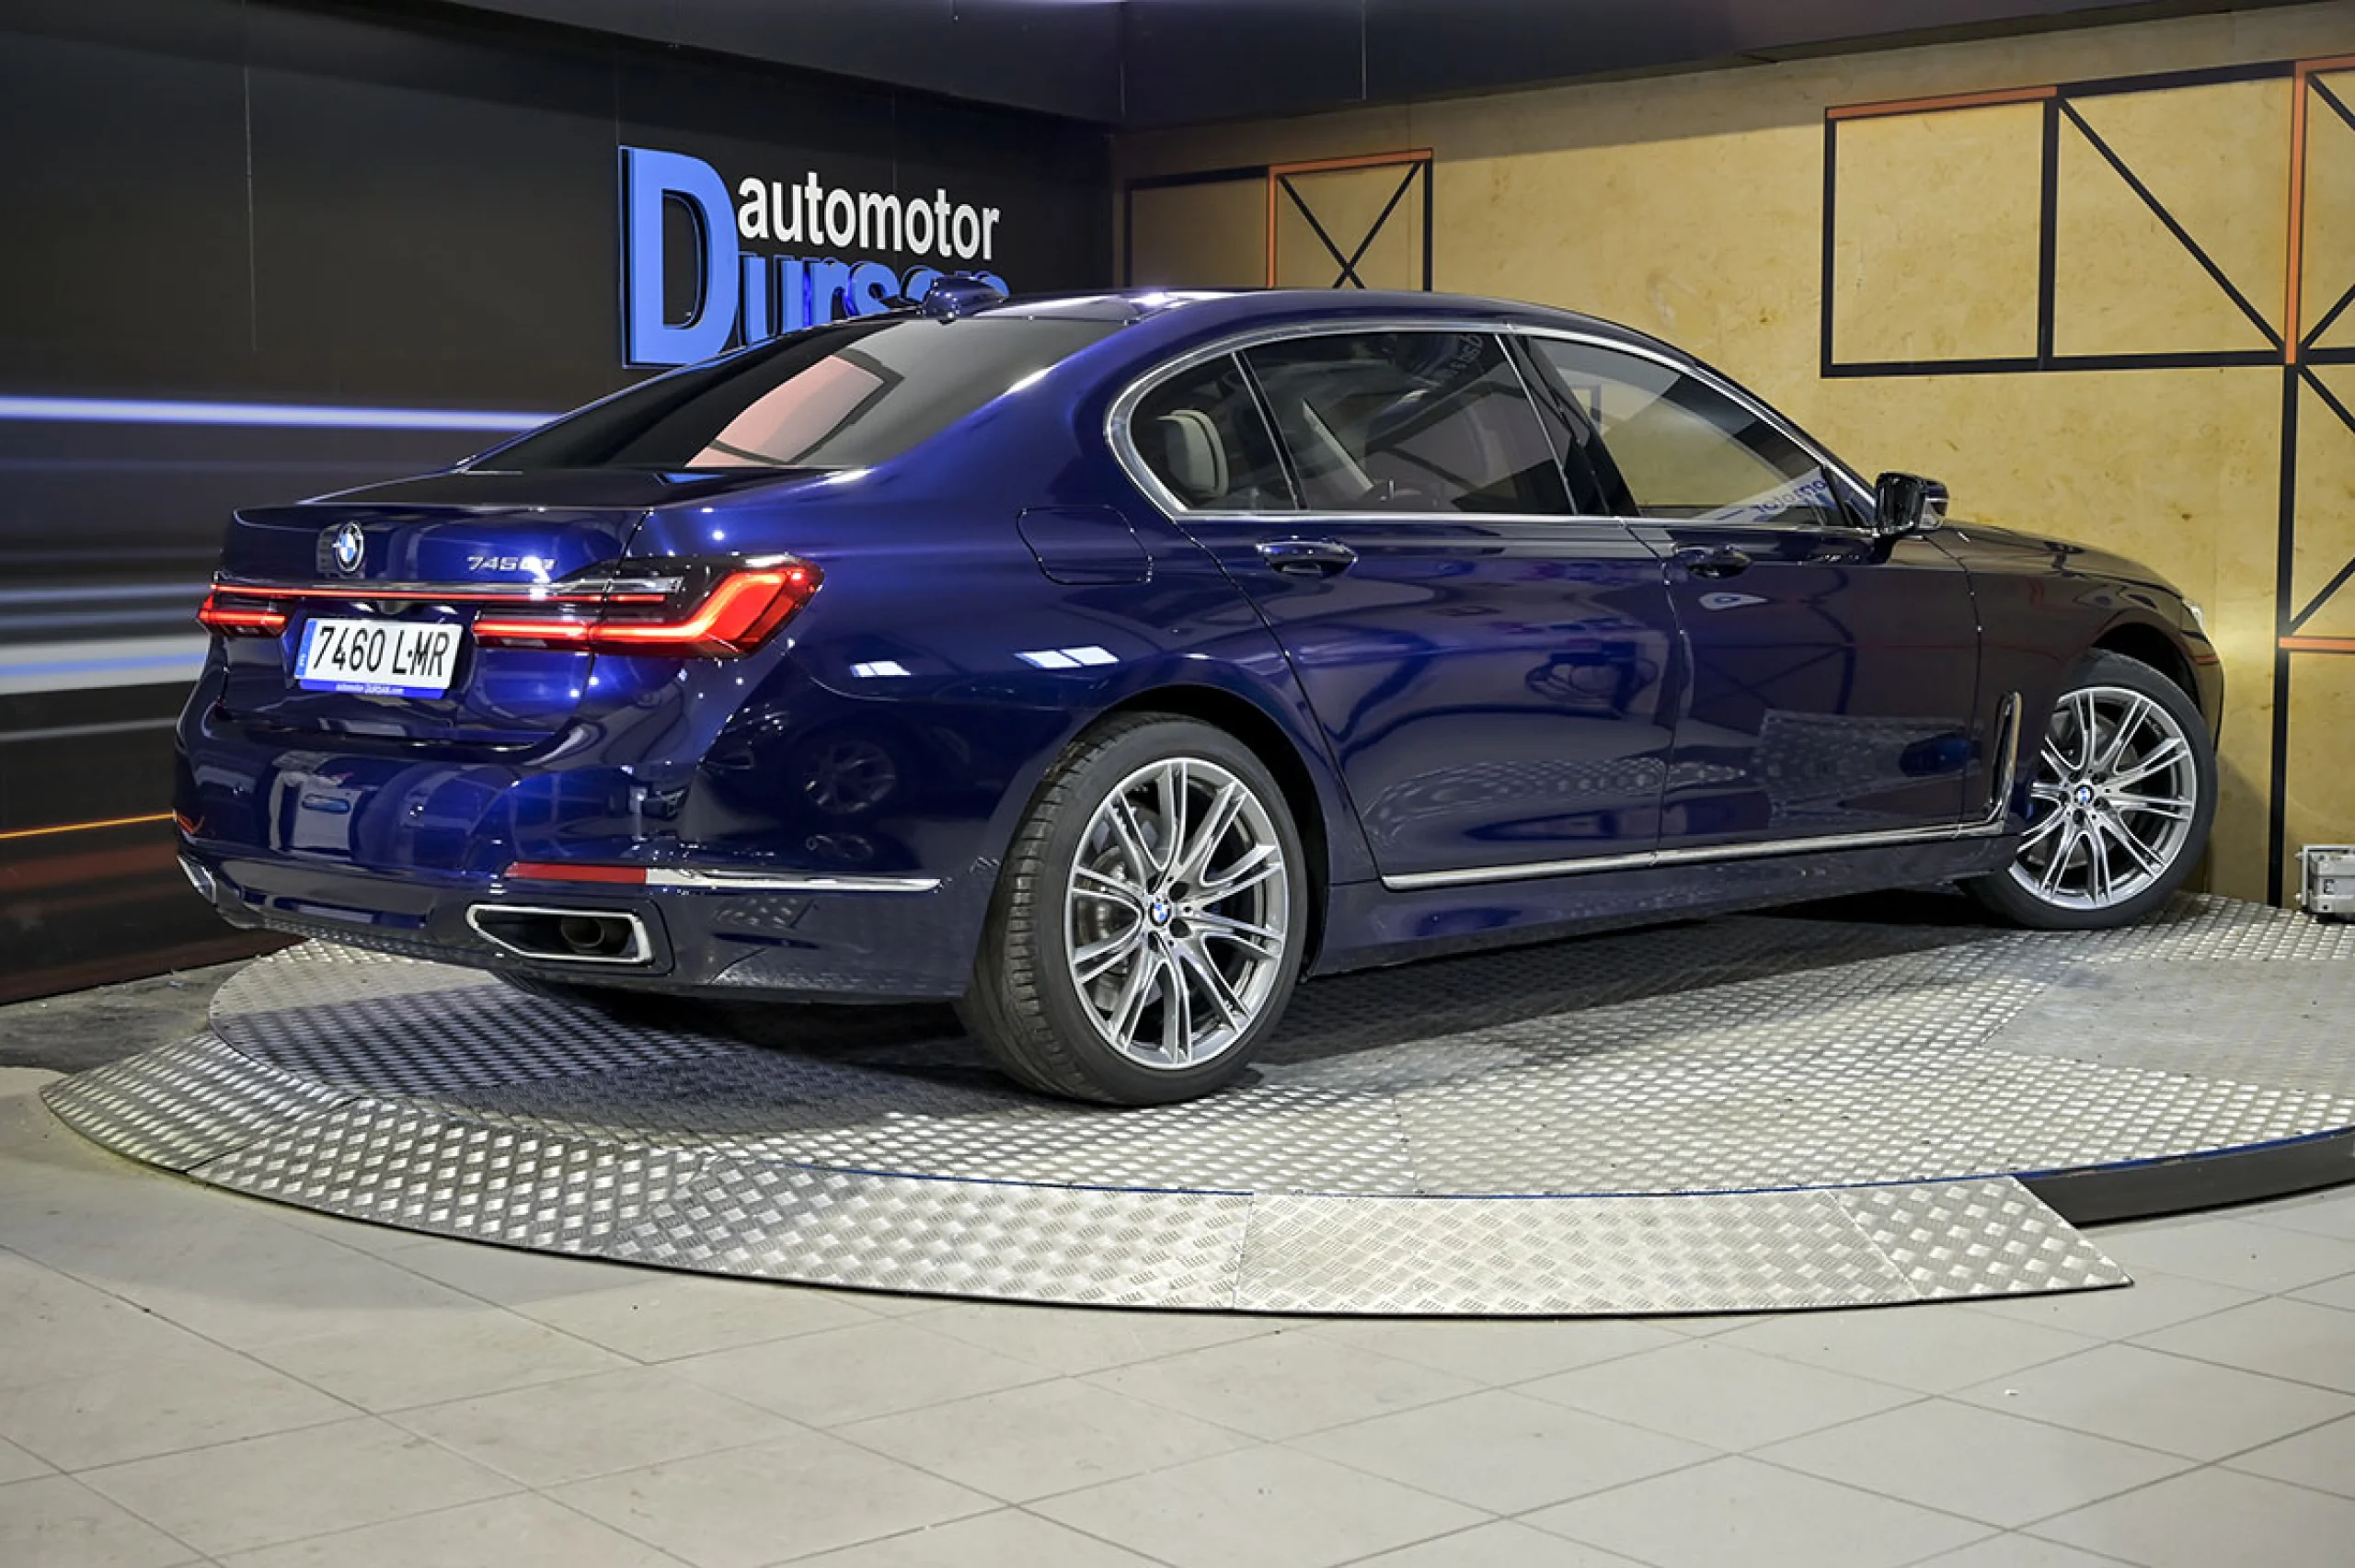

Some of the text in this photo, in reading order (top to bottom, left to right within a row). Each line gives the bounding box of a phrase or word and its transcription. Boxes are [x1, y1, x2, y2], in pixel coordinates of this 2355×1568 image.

[619, 145, 1009, 367] Durs
[739, 171, 1000, 259] automotor
[314, 625, 450, 677] 7460 LMR
